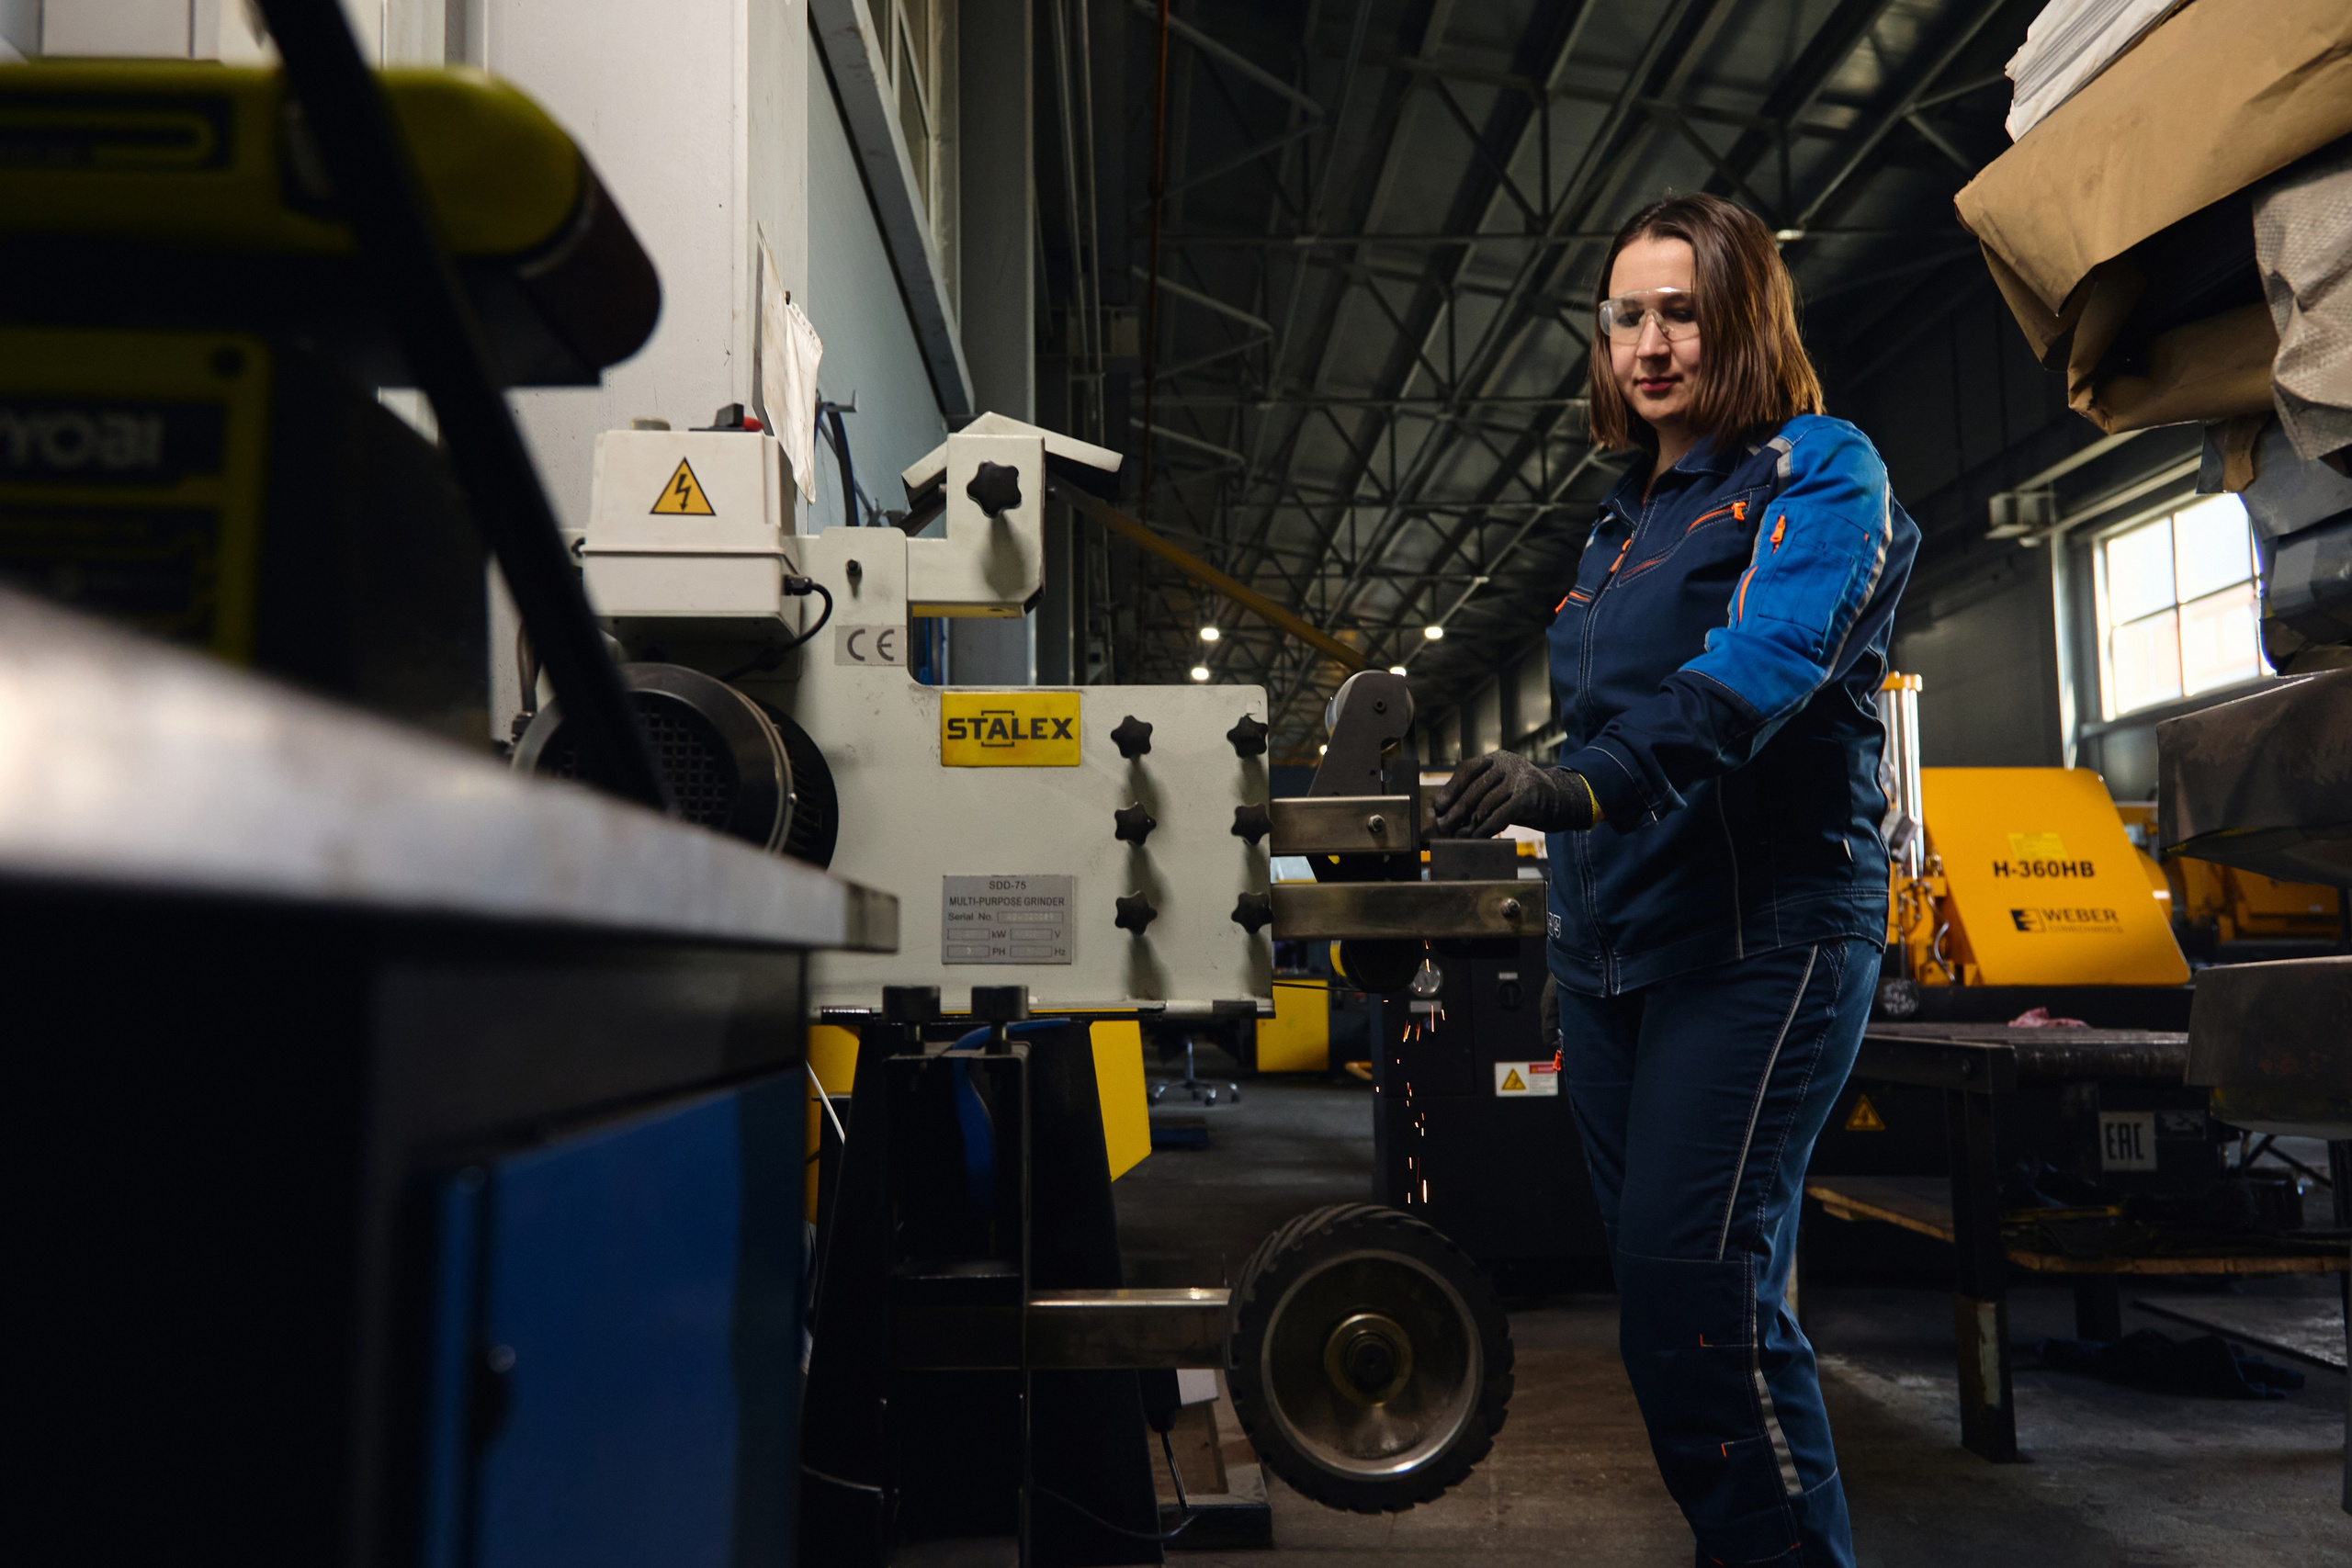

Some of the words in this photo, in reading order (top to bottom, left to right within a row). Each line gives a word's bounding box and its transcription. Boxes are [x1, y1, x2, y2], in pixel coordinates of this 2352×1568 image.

[0, 408, 164, 469] YOBI
[847, 628, 895, 661] CE
[947, 717, 1073, 739] STALEX
[1993, 861, 2095, 877] H-360HB
[989, 880, 1027, 890] SDD-75
[949, 897, 1022, 906] MULTI-PURPOSE
[1023, 897, 1065, 906] GRINDER
[948, 912, 974, 921] Serial
[2041, 908, 2120, 923] WEBER
[991, 930, 1007, 939] kW
[1054, 931, 1061, 939] V
[992, 947, 1006, 955] PH
[1054, 947, 1066, 956] Hz
[2106, 1123, 2144, 1159] EAC
